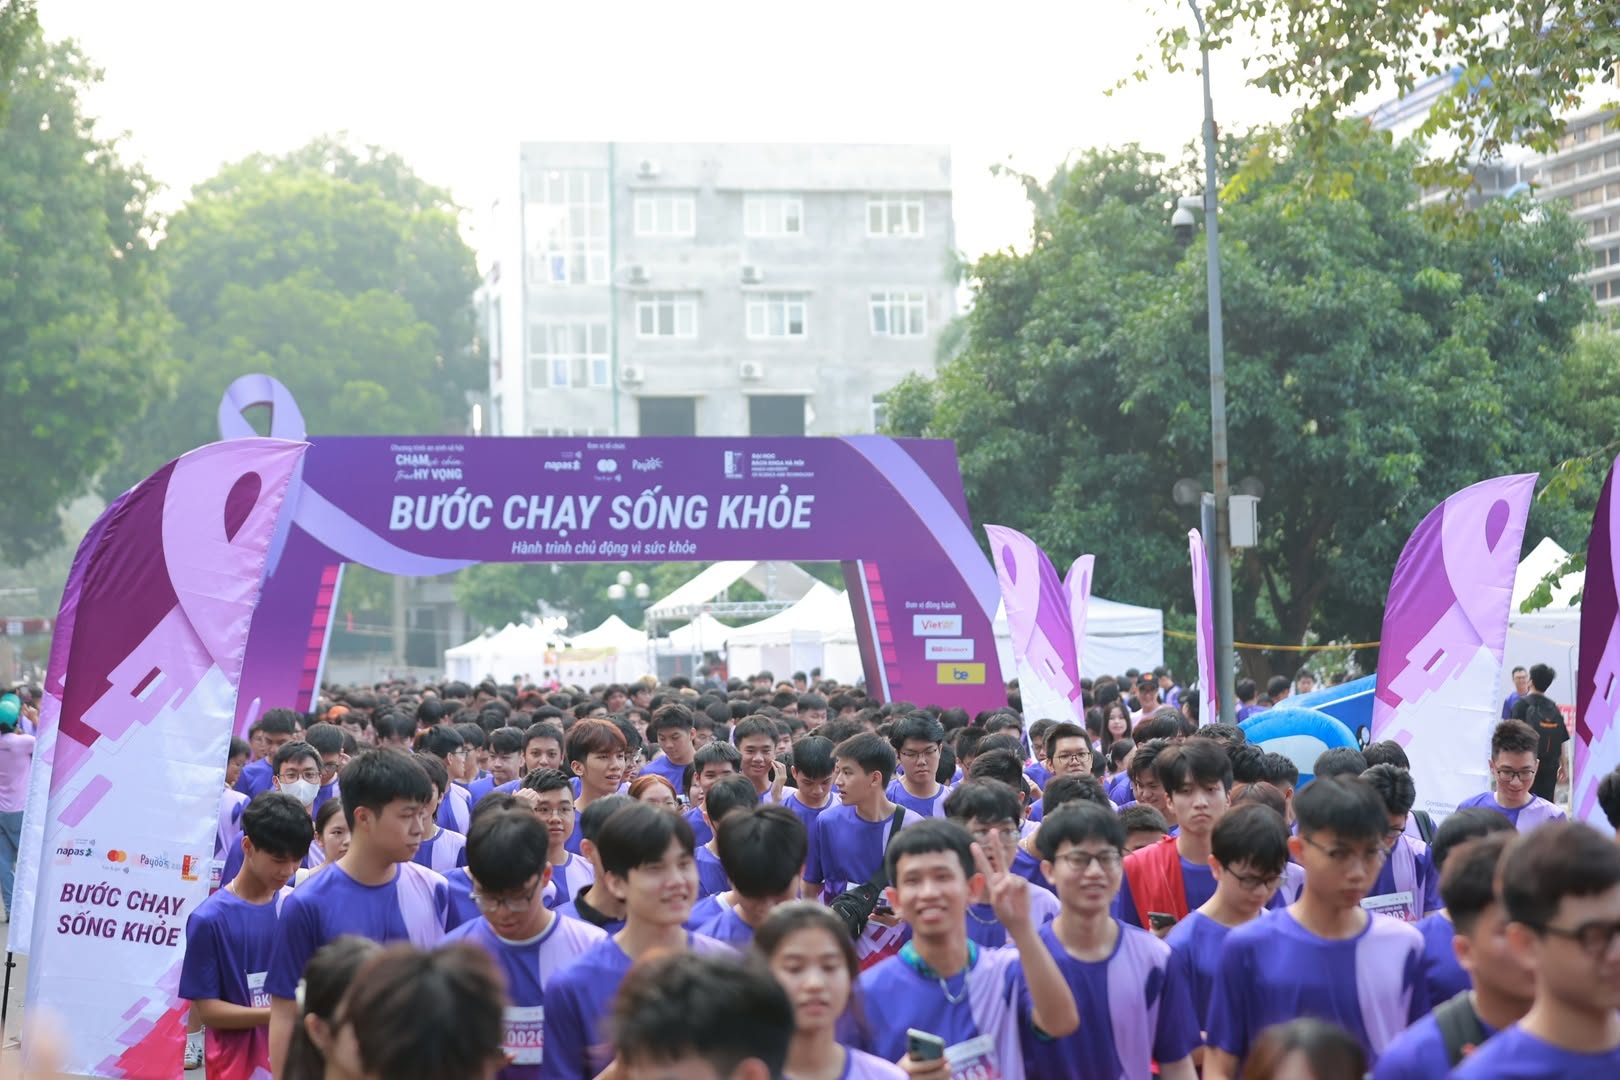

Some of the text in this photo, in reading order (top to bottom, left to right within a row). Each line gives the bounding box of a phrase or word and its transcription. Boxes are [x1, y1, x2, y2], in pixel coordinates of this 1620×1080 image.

[431, 468, 463, 482] VỌNG
[389, 484, 814, 537] BƯỚC CHẠY SỐNG KHỎE
[512, 540, 696, 557] Hành trình chủ động vì sức khỏe
[953, 667, 968, 680] be
[56, 847, 84, 857] napas
[60, 882, 186, 920] BƯỚC CHẠY
[57, 910, 181, 947] SỐNG KHỎE
[254, 992, 272, 1008] BK
